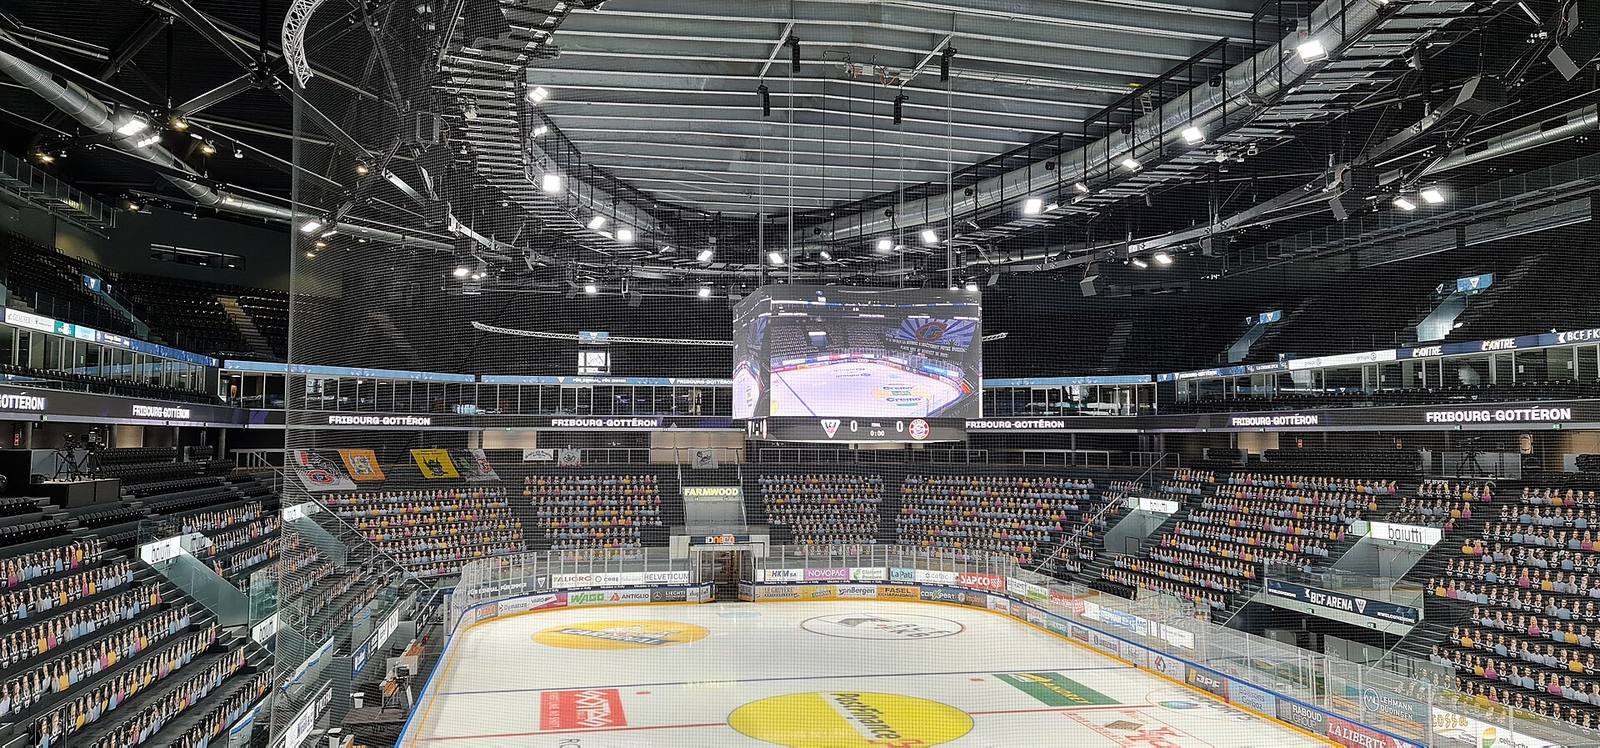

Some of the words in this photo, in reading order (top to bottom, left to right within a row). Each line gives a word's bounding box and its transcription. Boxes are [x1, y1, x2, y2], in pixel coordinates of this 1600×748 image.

[132, 404, 190, 418] FRIBOURG-GOTTÉRON
[1426, 405, 1571, 423] FRIBOURG-GOTTÉRON
[329, 415, 431, 426] FRIBOURG-GOTTÉRON
[552, 417, 658, 428] FRIBOURG-GOTTÉRON
[966, 418, 1064, 429] FRIBOURG-GOTTÉRON
[1232, 413, 1318, 426] FRIBOURG-GOTTÉRON
[850, 420, 858, 432] 0
[896, 420, 904, 432] 0
[684, 488, 739, 496] FARMWOOD
[1388, 525, 1422, 542] baiutti
[772, 570, 789, 578] HKM
[808, 569, 845, 578] NOVOPAC
[571, 592, 605, 604] WAGO
[1310, 592, 1327, 605] BCF
[1327, 595, 1353, 611] ARENA
[1380, 696, 1413, 711] LEHMANN
[1292, 705, 1322, 722] RABOUD
[1328, 722, 1342, 736] LA
[1343, 727, 1387, 748] LIBERTÉ
